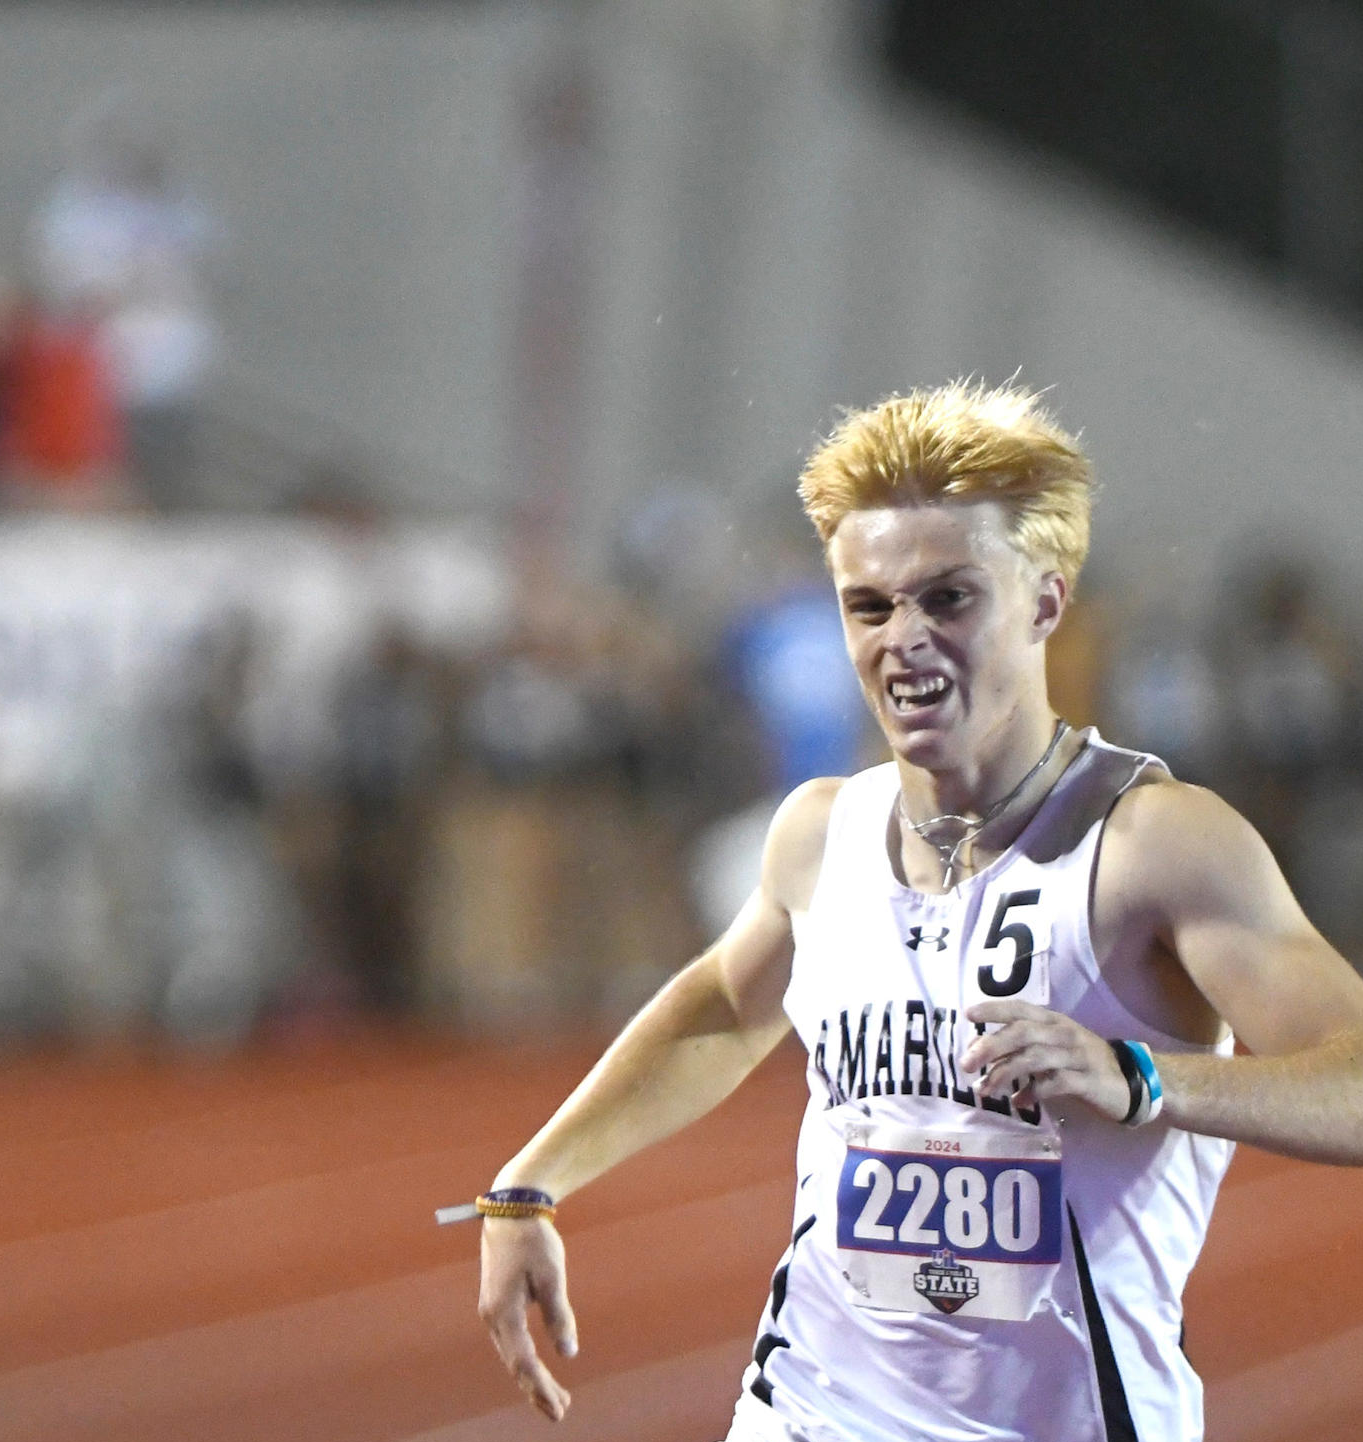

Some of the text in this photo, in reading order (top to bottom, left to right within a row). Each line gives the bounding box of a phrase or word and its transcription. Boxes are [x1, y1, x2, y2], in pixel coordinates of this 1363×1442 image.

[978, 888, 1041, 997] 5
[925, 1139, 961, 1153] 2024
[853, 1158, 1040, 1252] 2280
[914, 1273, 978, 1294] STATE
